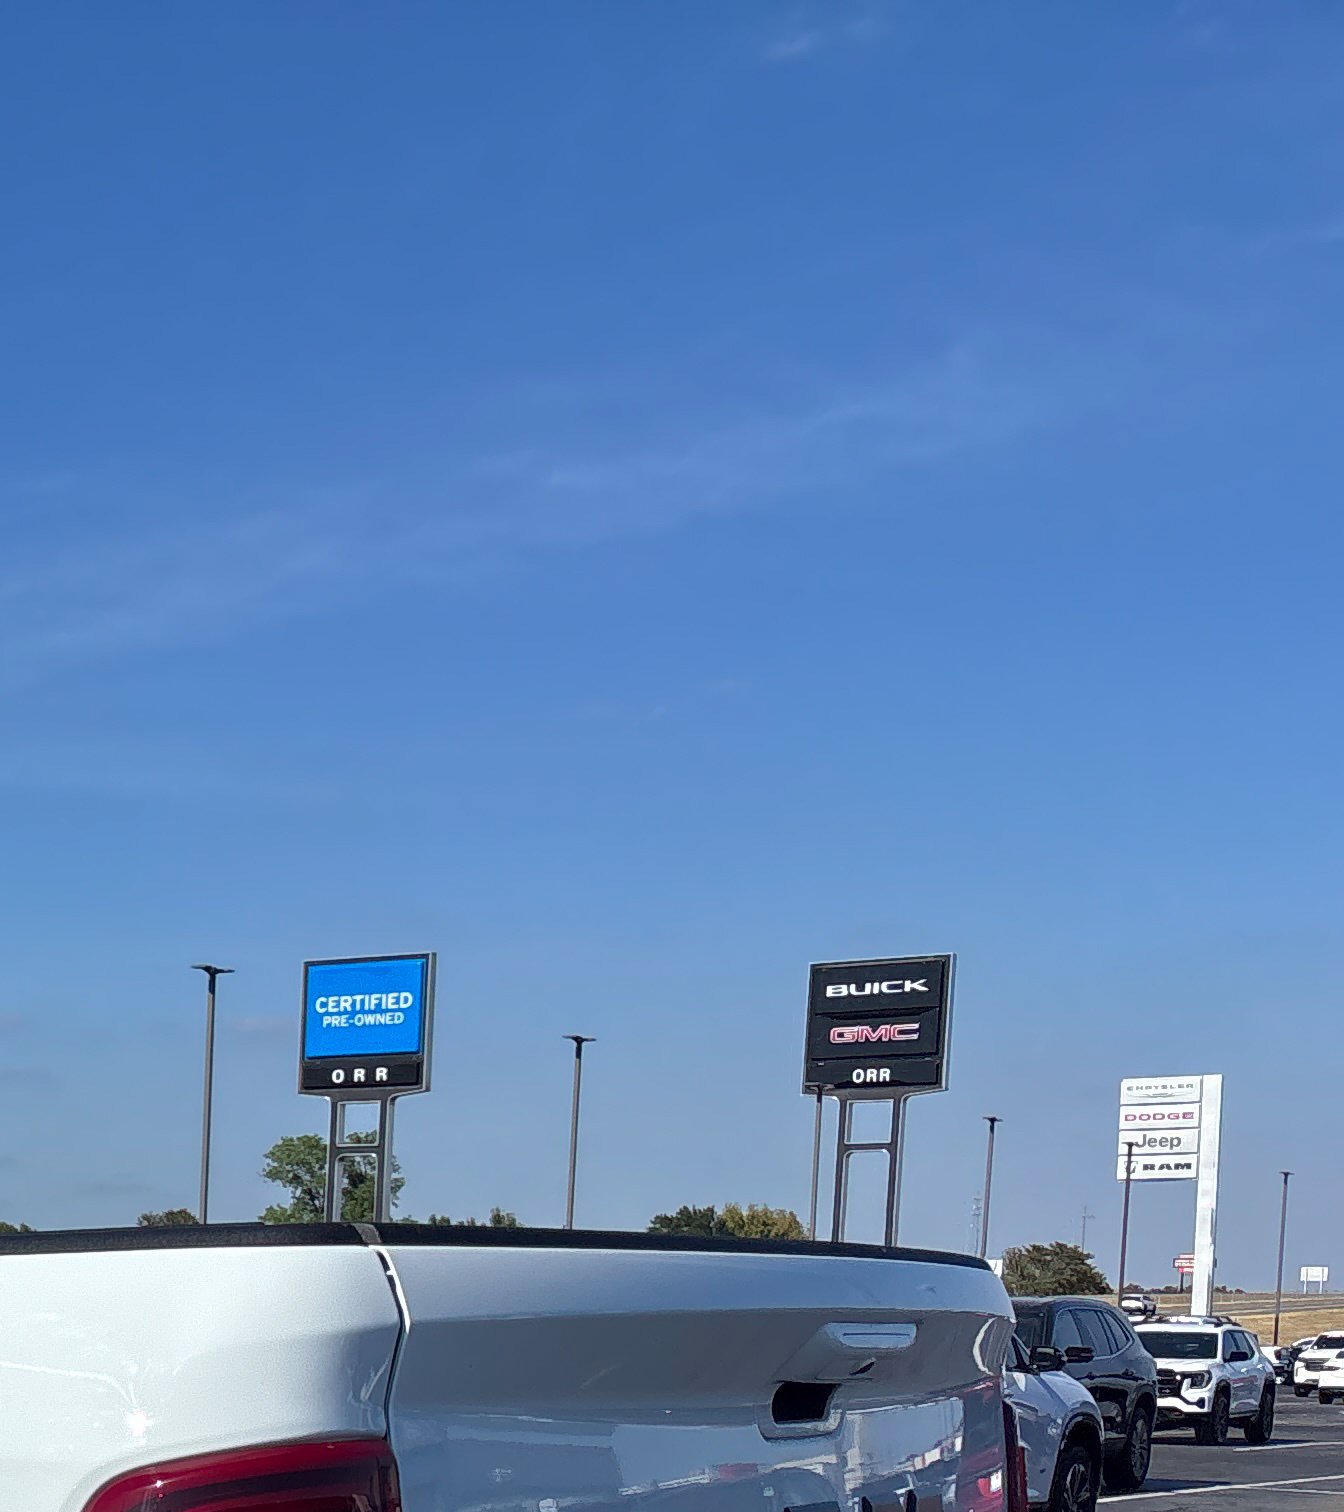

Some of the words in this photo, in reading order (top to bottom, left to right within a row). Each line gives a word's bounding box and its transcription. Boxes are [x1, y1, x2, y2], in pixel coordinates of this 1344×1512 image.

[825, 979, 930, 998] BUICK
[315, 992, 413, 1013] CERTIFIED
[322, 1012, 404, 1028] PRE-OWNED
[829, 1022, 920, 1043] GMC
[852, 1068, 891, 1083] ORR
[1126, 1083, 1193, 1091] CHRYSLER
[1124, 1112, 1194, 1121] DODGE
[1134, 1133, 1182, 1150] Jeep
[1142, 1162, 1192, 1171] RAM
